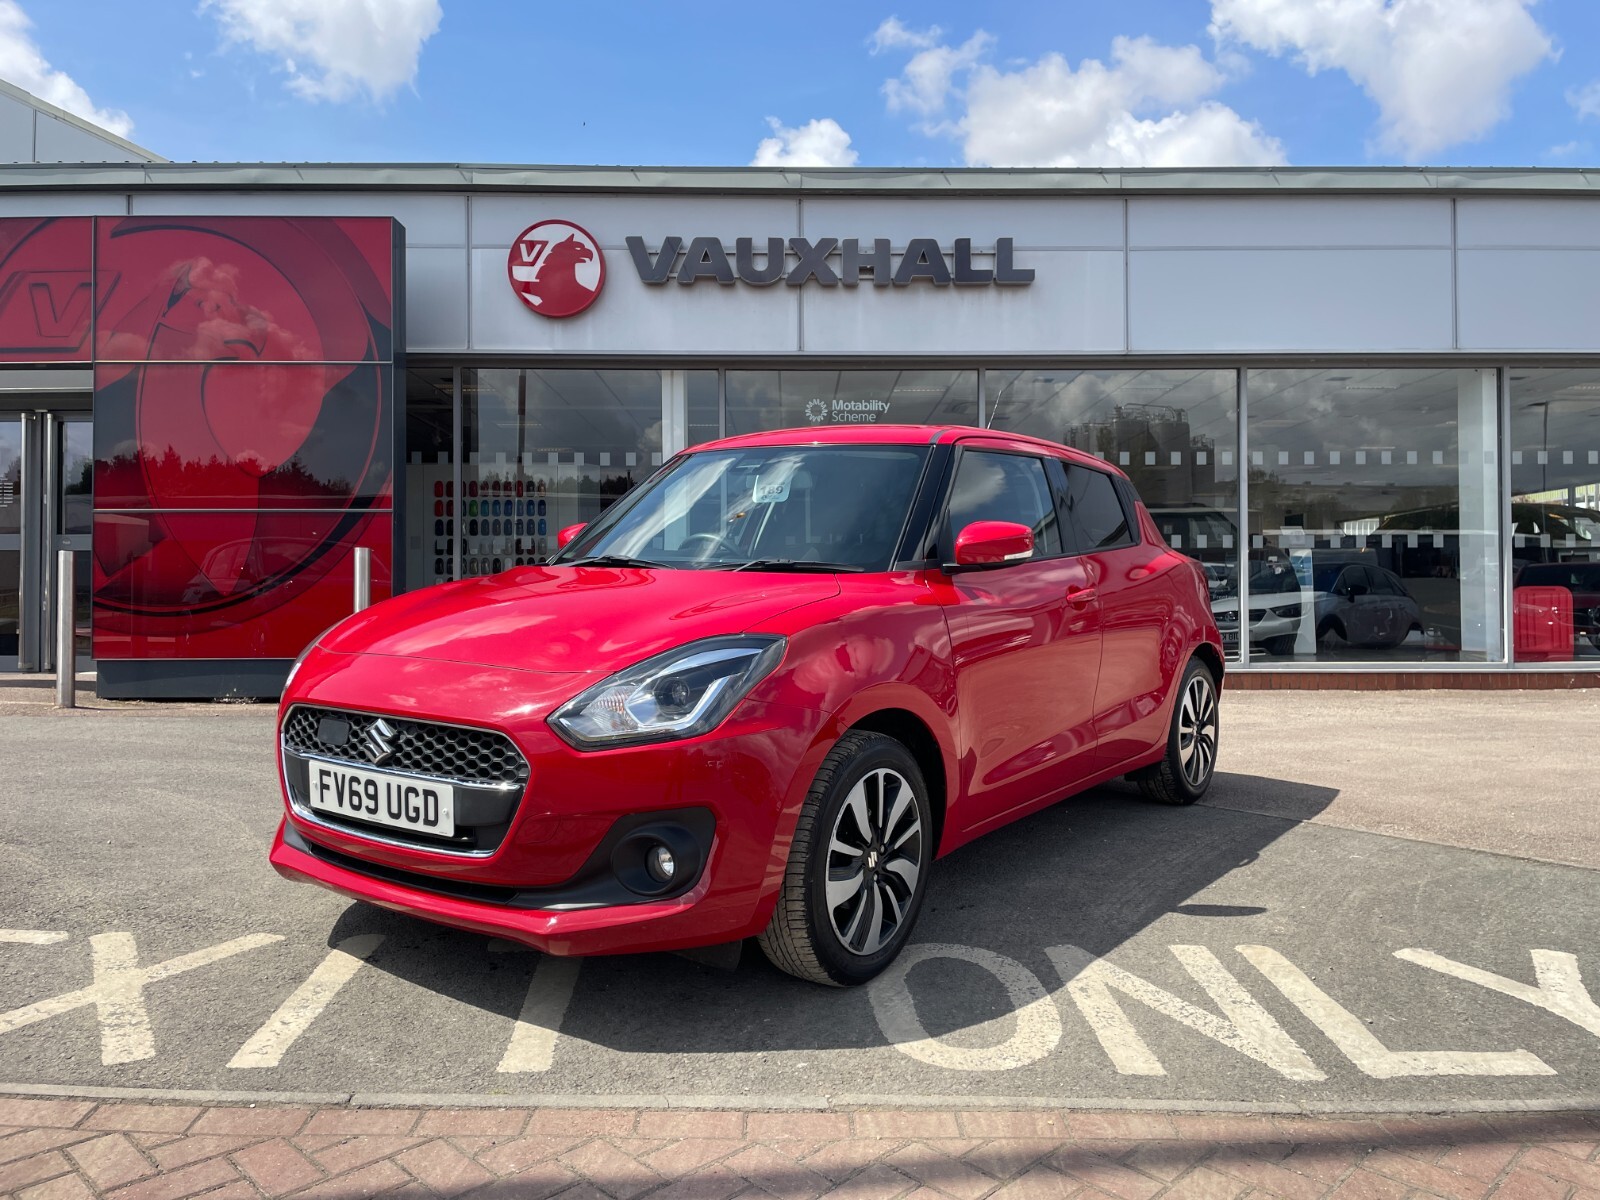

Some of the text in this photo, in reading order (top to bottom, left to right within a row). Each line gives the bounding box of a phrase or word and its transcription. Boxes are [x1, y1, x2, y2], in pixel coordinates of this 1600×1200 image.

[625, 235, 1036, 286] VAUXHALL
[832, 399, 890, 414] Motability
[832, 411, 876, 422] Scheme
[318, 768, 439, 827] FV69 UGD
[867, 943, 1600, 1082] ONLY
